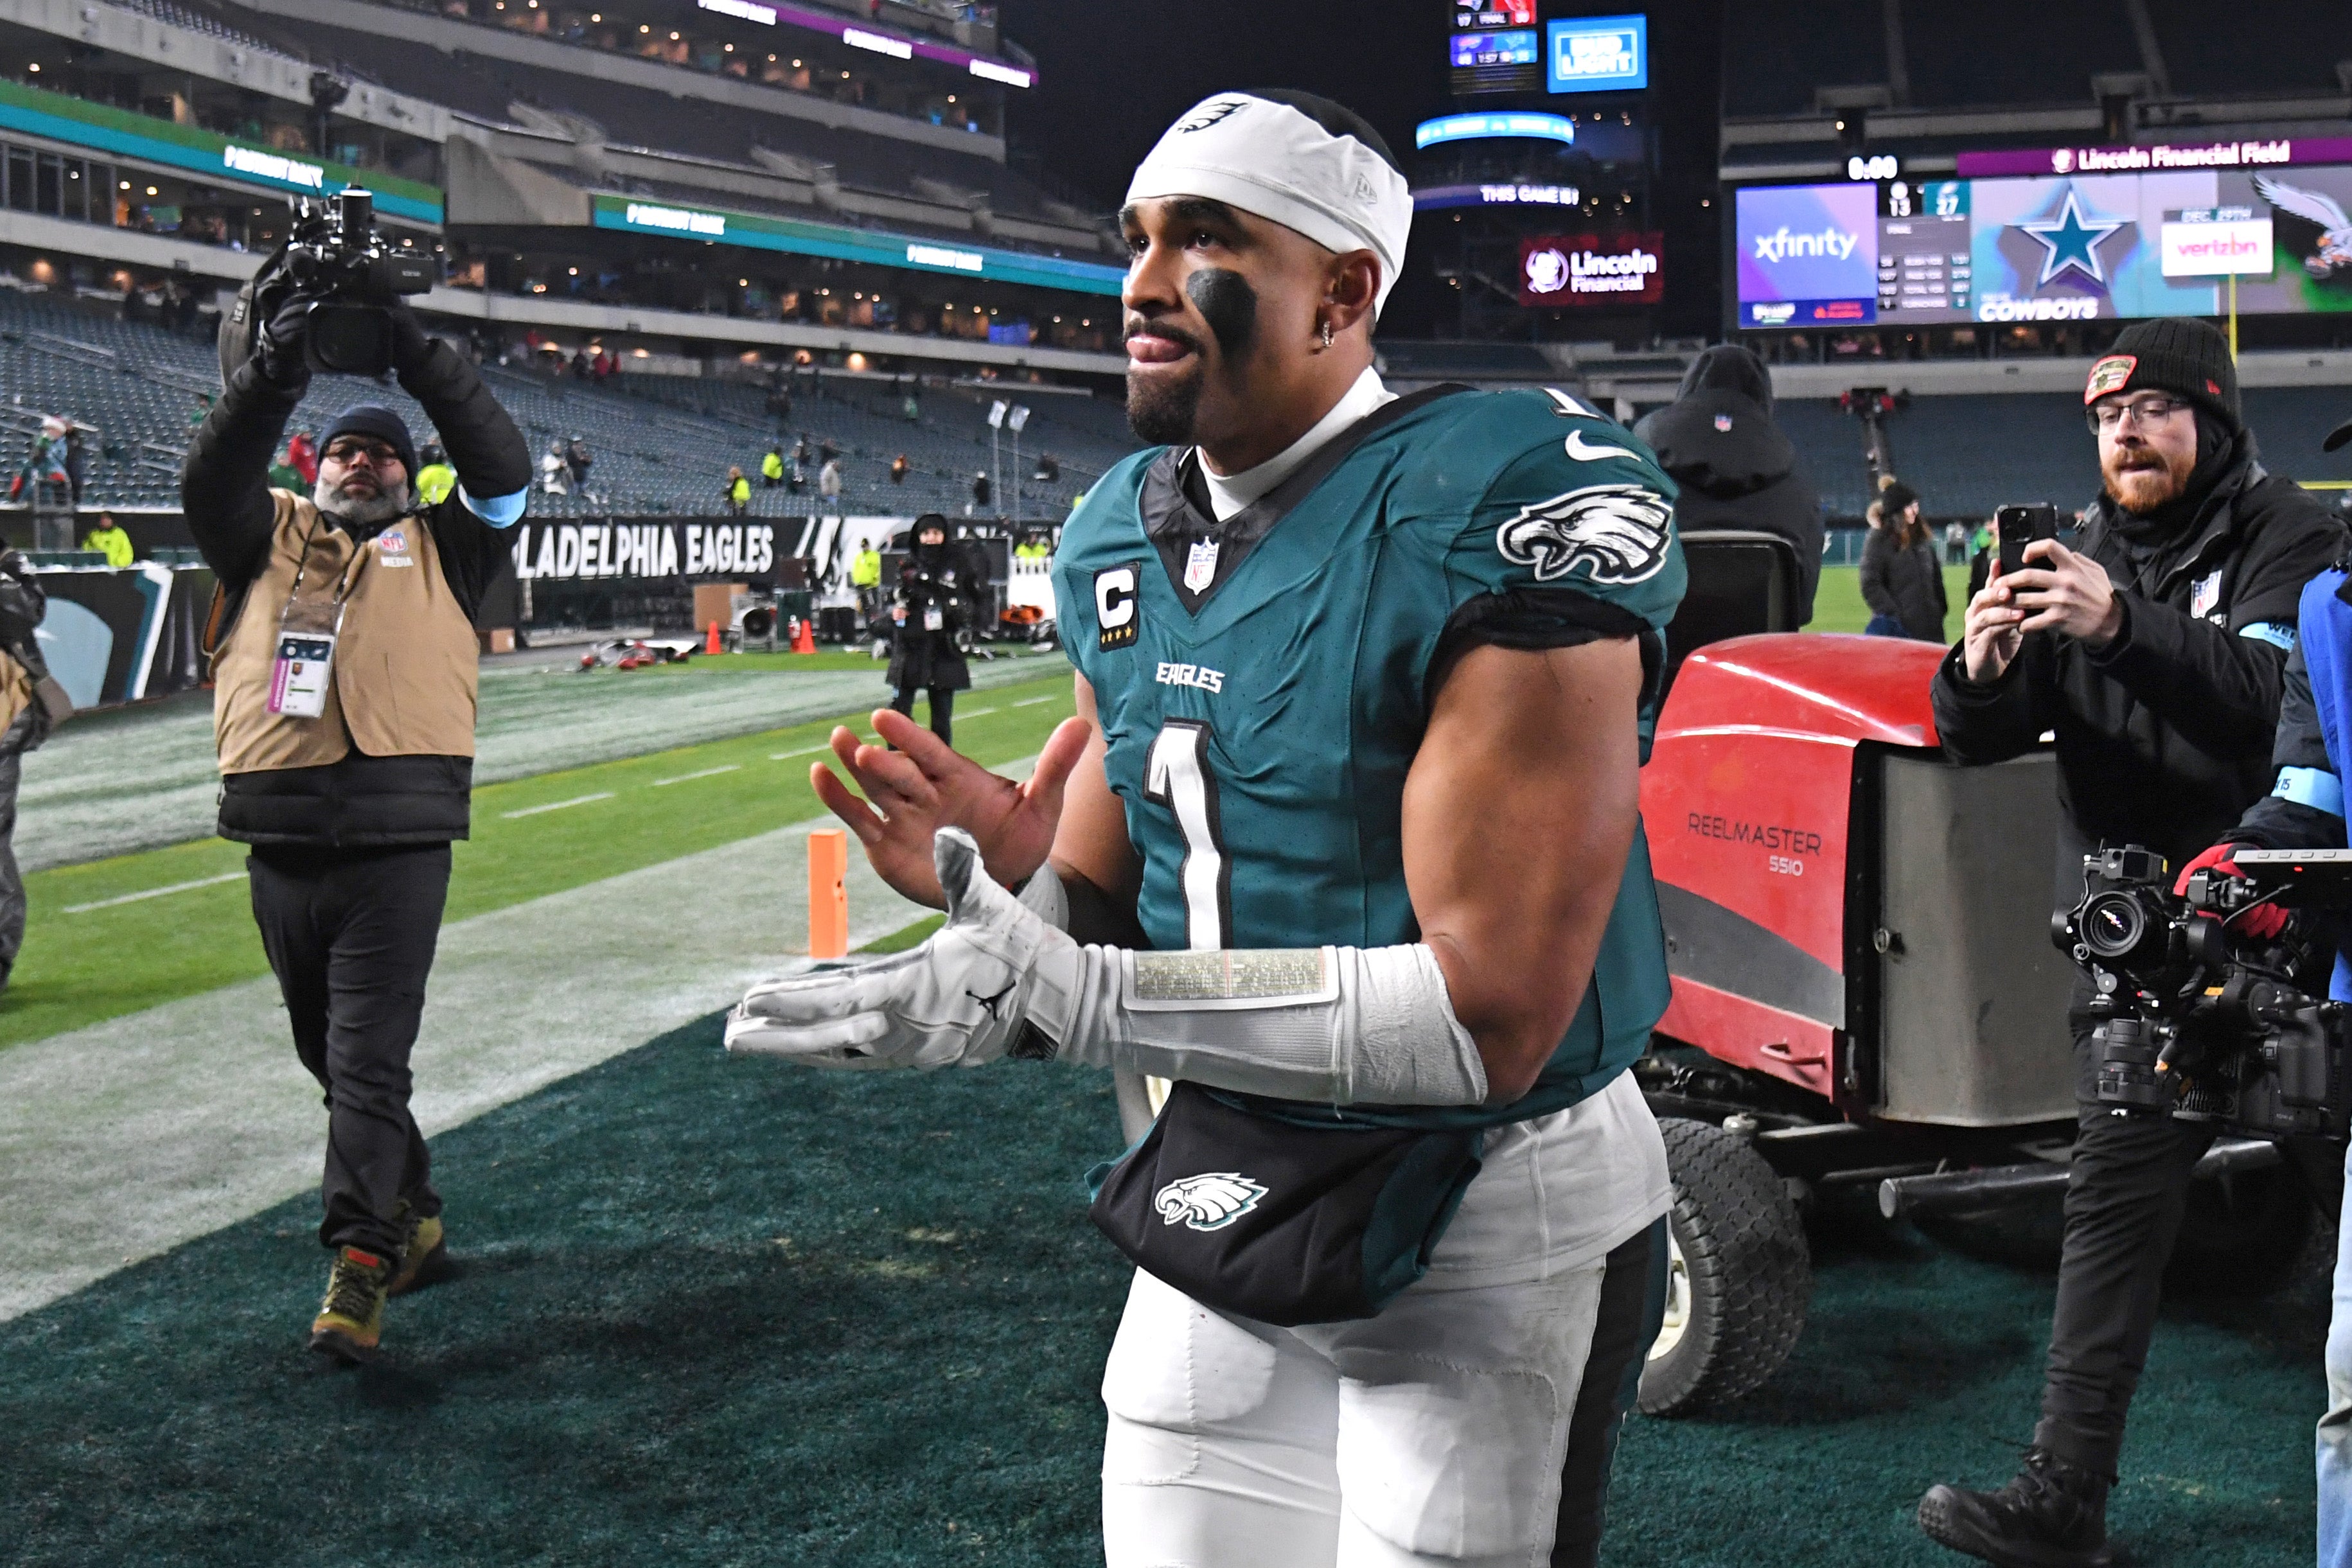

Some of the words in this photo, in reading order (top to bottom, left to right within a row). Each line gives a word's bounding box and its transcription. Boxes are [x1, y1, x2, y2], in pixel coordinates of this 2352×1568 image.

[1569, 35, 1623, 58] BUD
[1562, 51, 1631, 75] LIGHT
[1848, 156, 1898, 180] 0:00
[2078, 146, 2150, 170] Lincoln
[2152, 145, 2239, 167] Financial
[2241, 140, 2290, 163] Field
[1480, 184, 1516, 202] THIS
[1889, 197, 1911, 216] 13
[1755, 226, 1859, 263] xfinity
[2178, 239, 2258, 257] verizon
[1571, 248, 1657, 276] Lincoln
[1571, 274, 1645, 293] Financial
[1978, 296, 2099, 322] COWBOYS
[512, 524, 678, 579] LADELPHIA
[685, 524, 774, 576] EAGLES
[1095, 568, 1135, 629] C
[1156, 662, 1225, 693] EAGLES
[1144, 718, 1232, 950] 1
[1688, 813, 1822, 856] REELMASTER
